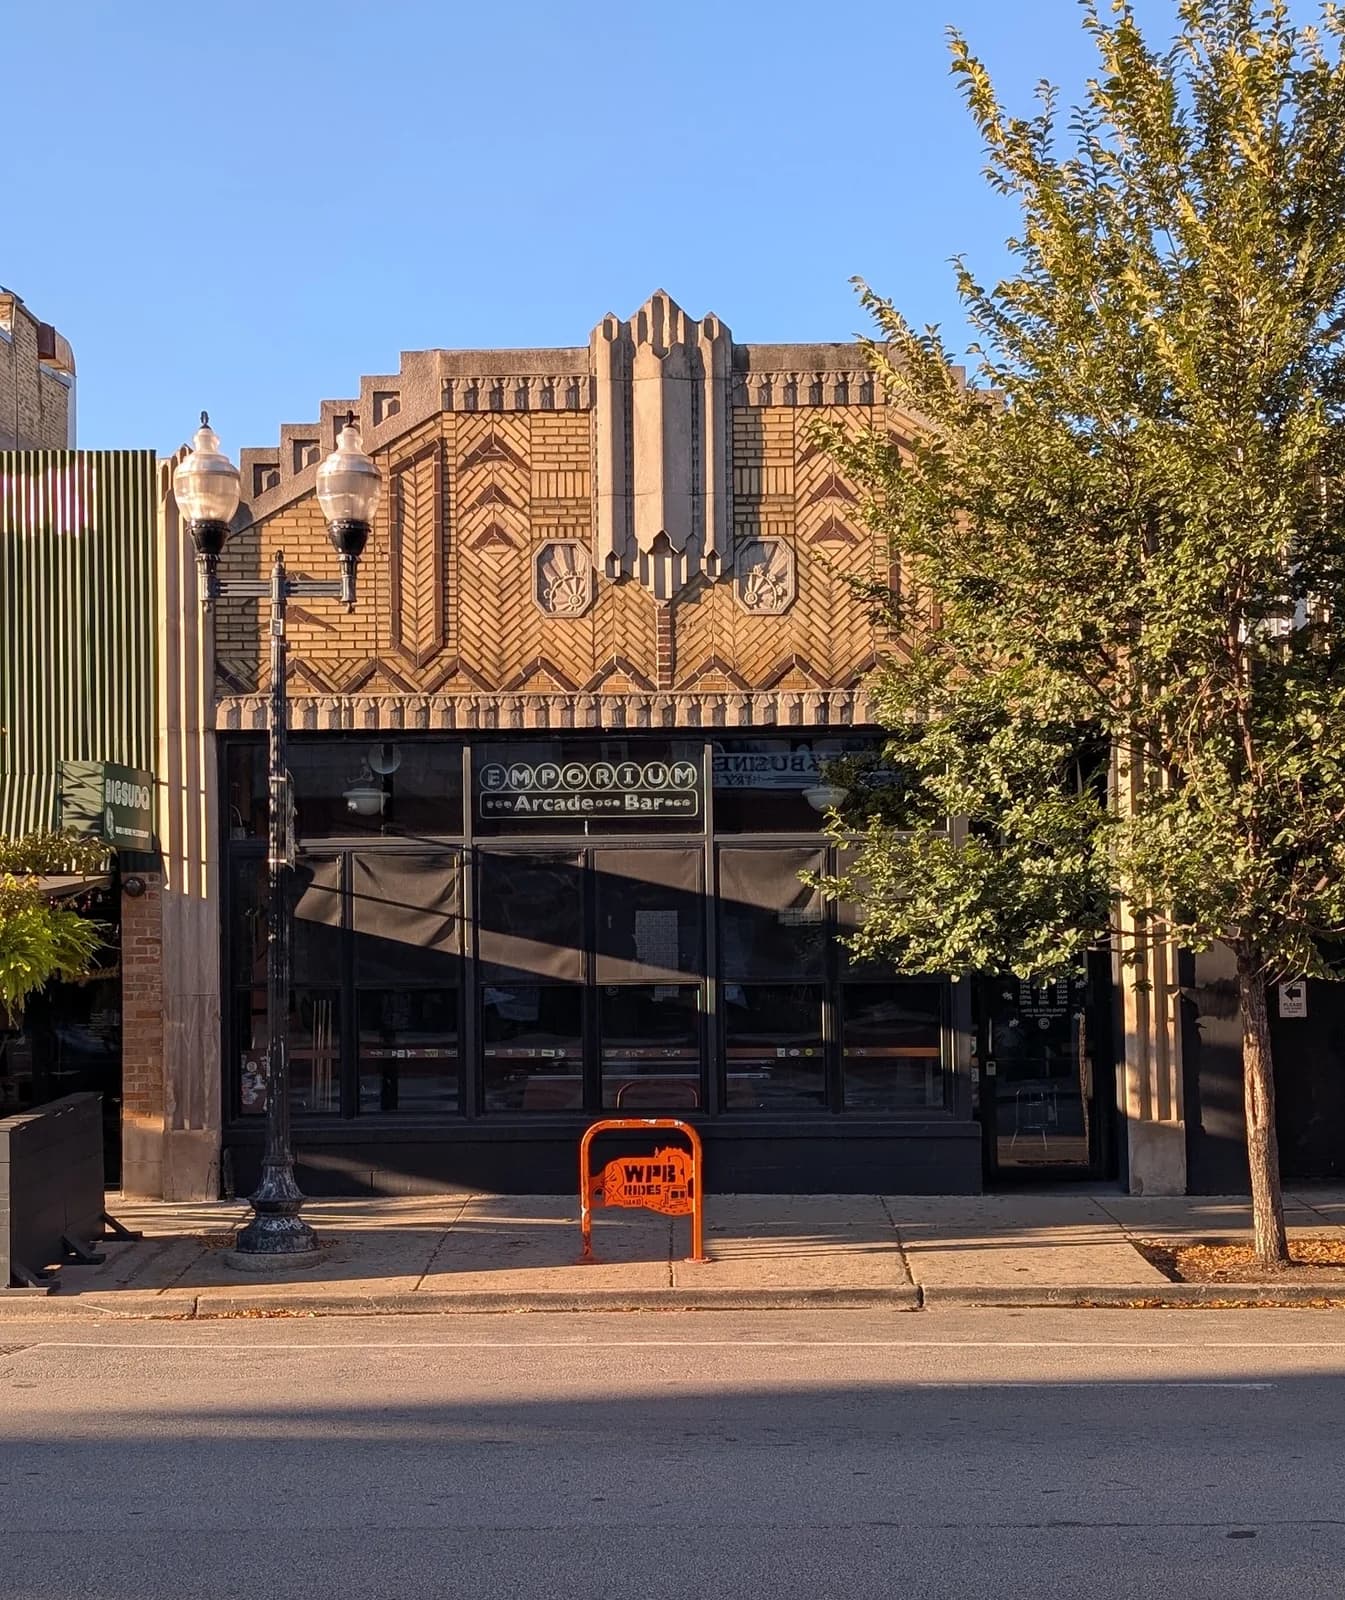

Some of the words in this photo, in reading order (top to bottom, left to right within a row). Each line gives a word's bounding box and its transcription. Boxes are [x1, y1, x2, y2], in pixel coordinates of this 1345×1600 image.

[485, 766, 693, 787] EMPORIUM
[514, 795, 594, 812] Arcade
[624, 794, 665, 811] Bar
[624, 1164, 676, 1183] WPB
[624, 1184, 661, 1196] RIDES
